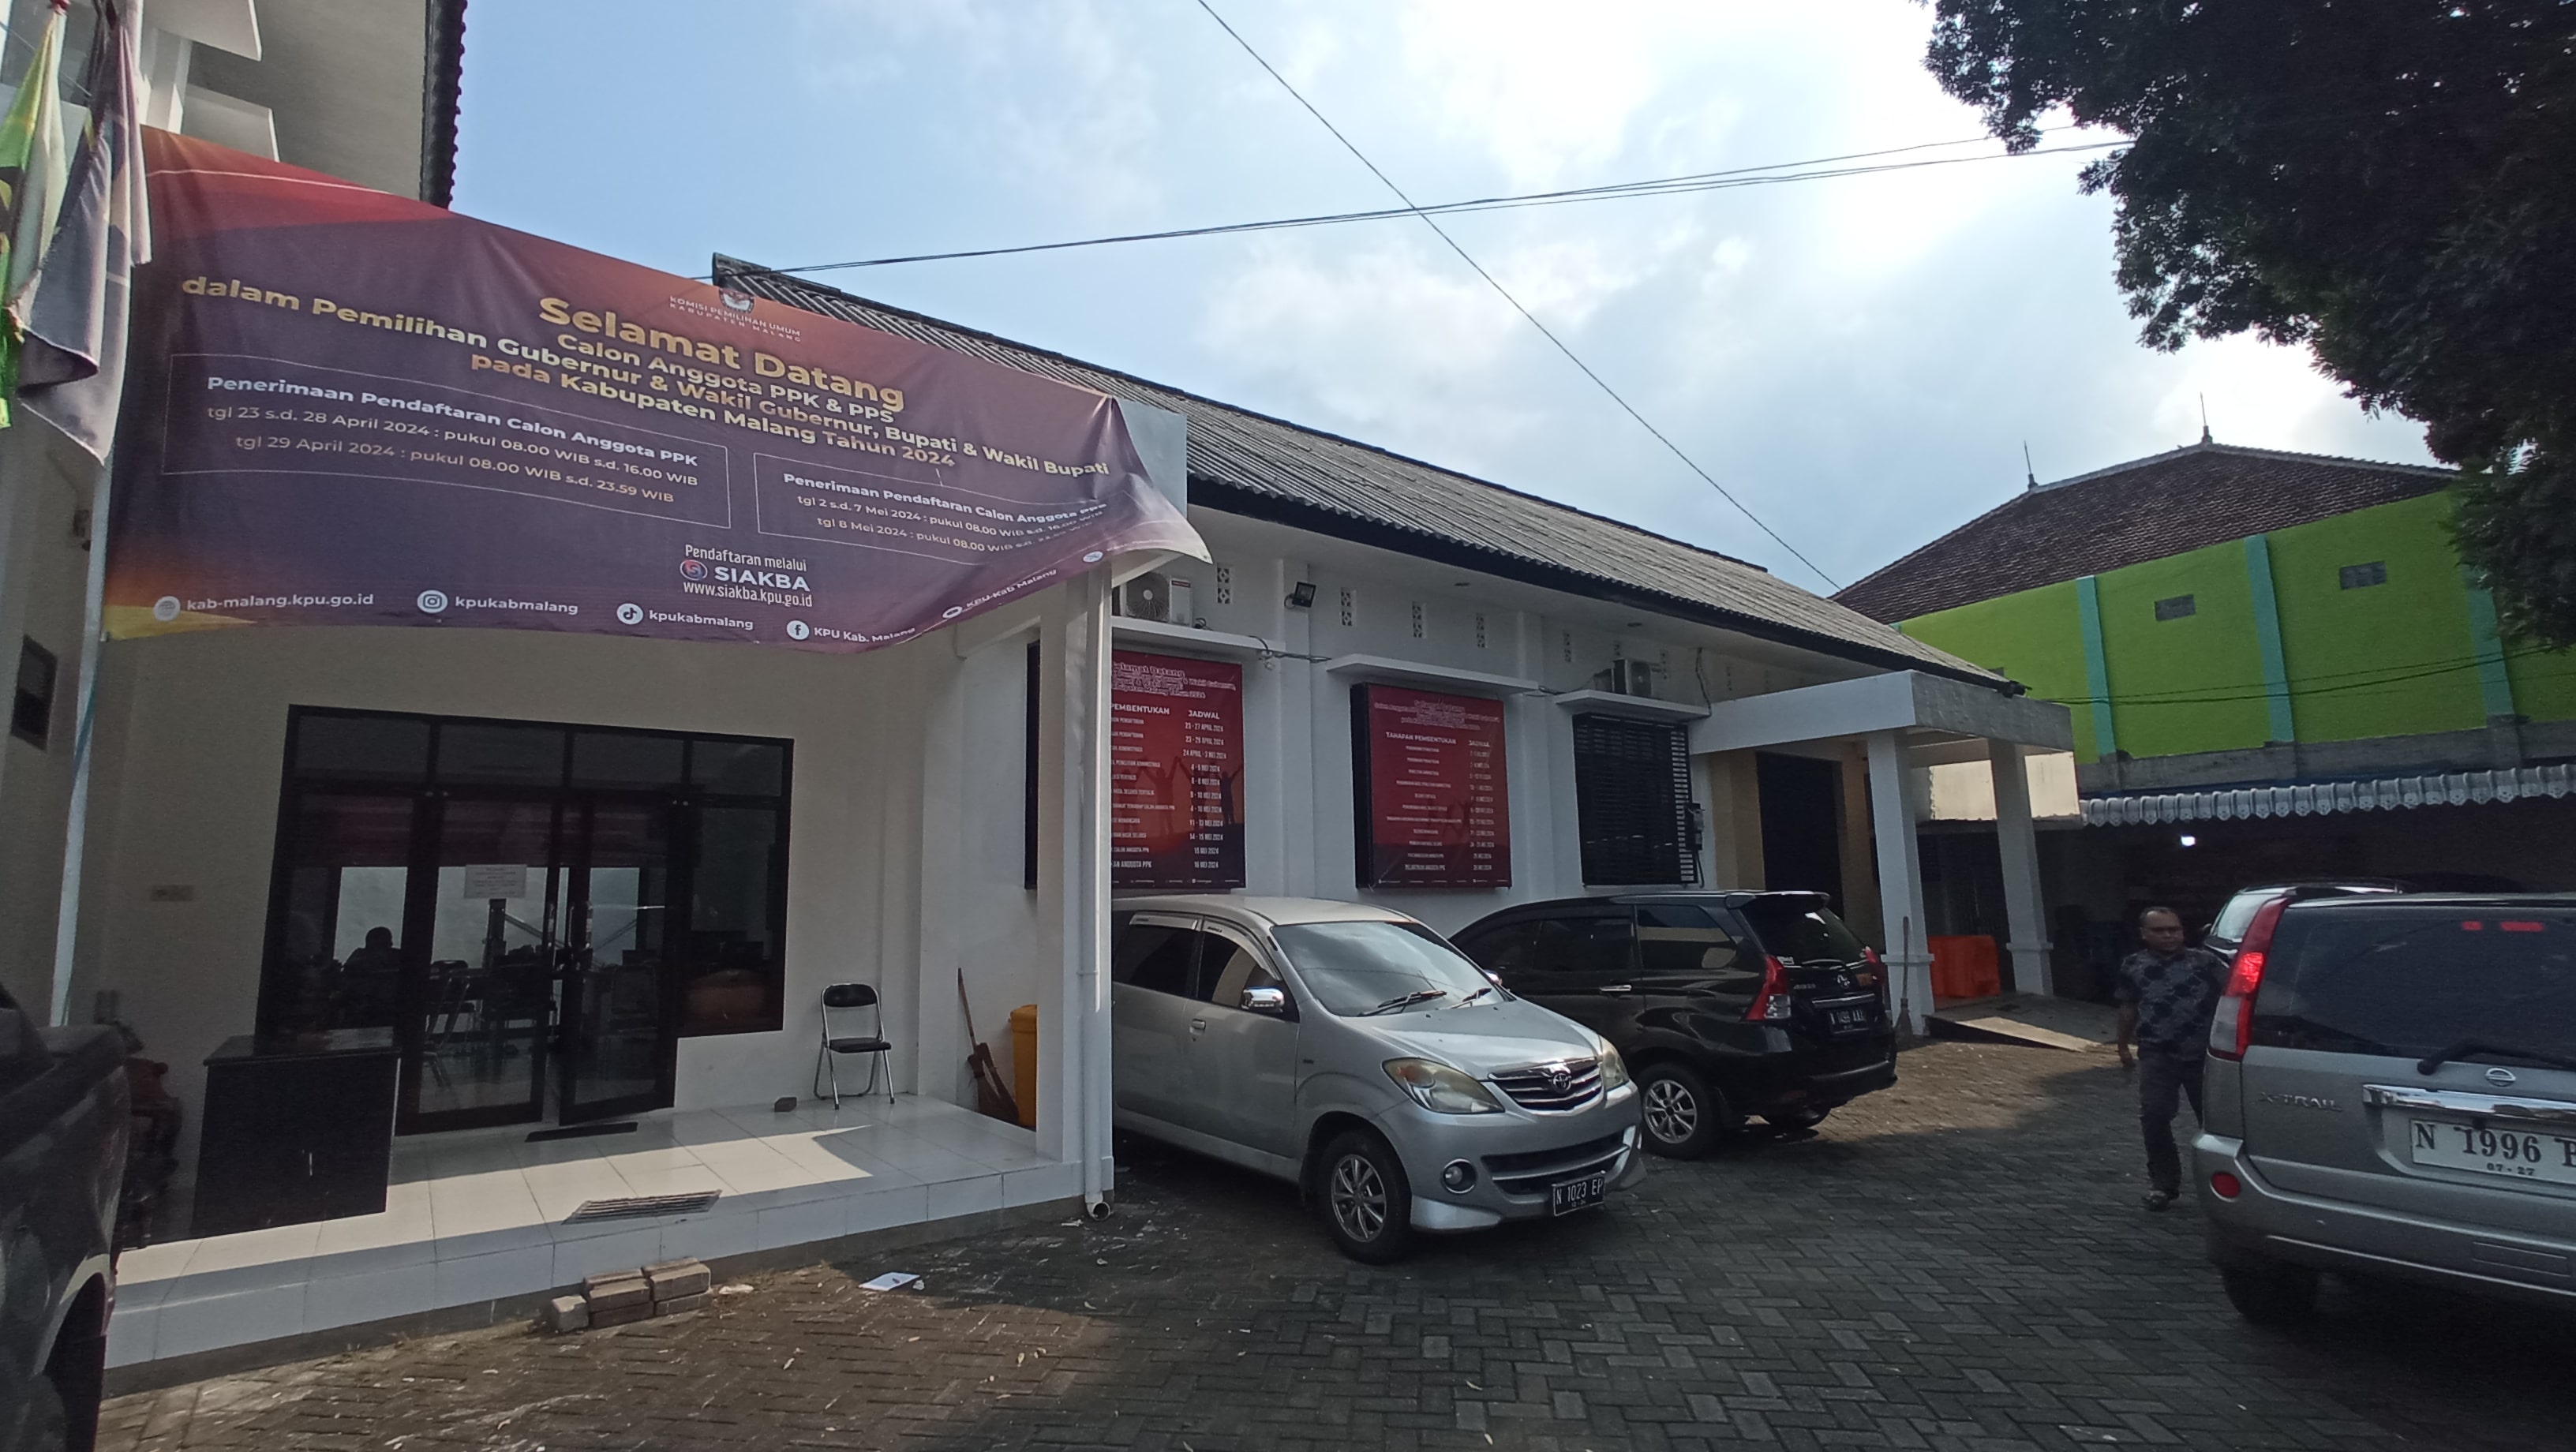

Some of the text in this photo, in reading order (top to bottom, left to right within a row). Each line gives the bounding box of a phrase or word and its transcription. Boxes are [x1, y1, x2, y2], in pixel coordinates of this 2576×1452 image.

[670, 296, 800, 336] KOMISI PEMILIHAN UMUM
[670, 303, 801, 342] KABUPATEN MALANG
[539, 297, 905, 413] Selamat Datang
[182, 276, 1110, 477] dalam Pemilihan Gubernur & Wakil Gubernur, Bupati & Wakil Bupati
[557, 334, 894, 423] Calon Anggota PPK & PPS
[208, 376, 698, 466] Penerimaan Pendaftaran Calon Anggota PPK
[471, 354, 956, 467] pada Kabupaten Malang Tahun 2024
[208, 406, 232, 421] tgl
[238, 407, 260, 419] 23
[264, 409, 298, 421] s.d.
[303, 411, 327, 423] 28
[332, 414, 378, 428] April
[384, 421, 430, 436] 2024
[444, 431, 496, 447] pukul
[501, 439, 550, 455] 08.00
[555, 448, 590, 464] WIB
[594, 458, 620, 470] s.d.
[623, 463, 662, 480] 16.00
[666, 472, 698, 486] WIB
[235, 436, 261, 450] tgl
[267, 437, 290, 448] 29
[296, 438, 343, 452] April
[348, 443, 395, 456] 2024
[410, 451, 463, 466] pukul
[469, 458, 519, 473] 08.00
[524, 466, 561, 481] WIB
[566, 475, 593, 487] s.d.
[597, 480, 637, 496] 23.59
[642, 488, 674, 503] WIB
[783, 473, 880, 498] Penerimaan
[883, 490, 972, 514] Pendaftaran
[975, 506, 1014, 522] Calon
[1017, 511, 1077, 523] Anggota
[797, 495, 815, 507] tgl
[818, 499, 827, 507] 2
[829, 501, 852, 511] s.d.
[865, 506, 888, 517] Mei
[891, 510, 921, 522] 2024
[930, 515, 963, 529] pukul
[965, 522, 997, 536] 08.00
[999, 529, 1024, 537] WIB
[817, 517, 835, 529] tgl
[839, 520, 848, 529] 8
[851, 522, 874, 533] Mei
[877, 526, 907, 537] 2024
[916, 531, 950, 545] pukul
[953, 538, 985, 552] 08.00
[685, 544, 807, 572] Pendaftaran melalui
[683, 582, 813, 608] www.siakba.kpu.go.id
[714, 566, 811, 592] SIAKBA
[186, 593, 374, 611] kab-malang.kpu.go.id
[455, 596, 578, 616] kpukabmalang
[649, 610, 754, 631] kpukabmalang
[814, 627, 915, 643] KPU Kab. Malang
[1188, 709, 1220, 720] JADWAL
[2415, 1123, 2436, 1150] N
[2458, 1128, 2542, 1163] 1996
[1556, 1188, 1562, 1204] N
[1567, 1181, 1587, 1202] 1023
[1592, 1178, 1603, 1196] EP
